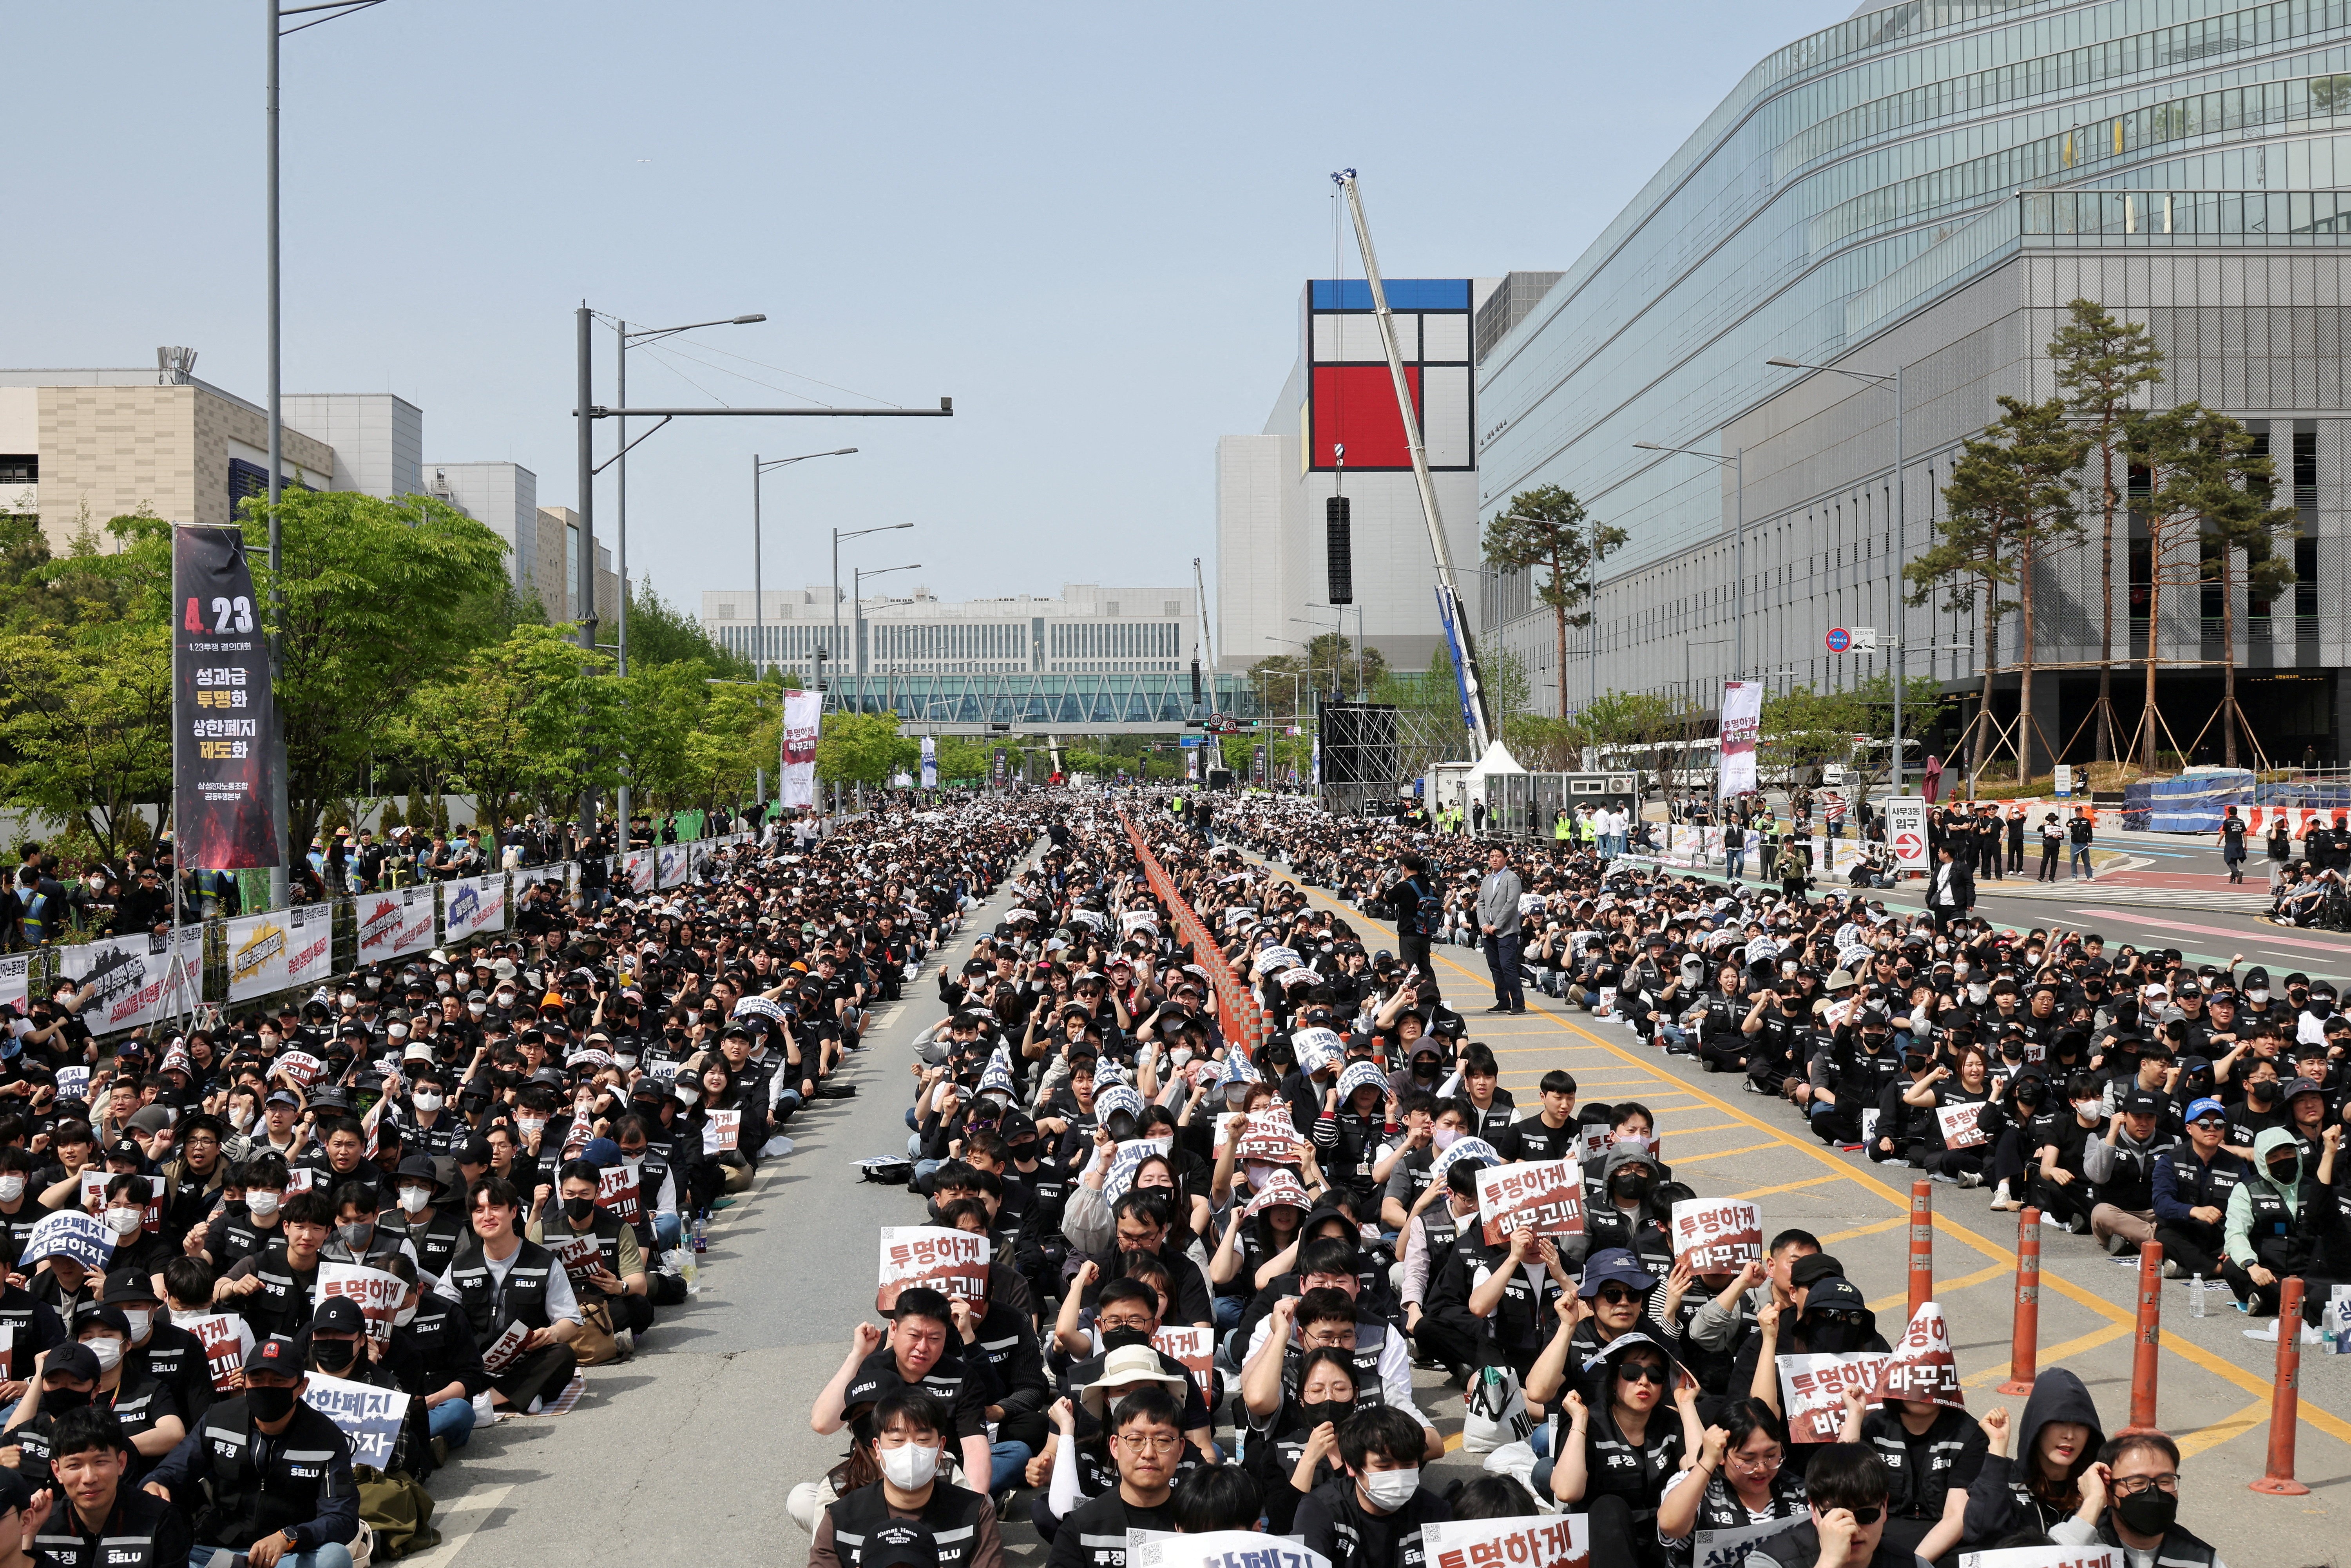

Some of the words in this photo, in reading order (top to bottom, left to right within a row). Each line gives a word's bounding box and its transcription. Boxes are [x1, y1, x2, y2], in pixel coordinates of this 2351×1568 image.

[185, 596, 253, 636] 4.23
[189, 643, 218, 651] 4.23투쟁
[220, 642, 252, 651] 결의대회
[196, 668, 246, 686] 성과급
[197, 690, 248, 708] 투명화
[193, 718, 256, 737] 상한폐지
[1724, 716, 1756, 729] 투명하게
[786, 726, 814, 739] 투명하게
[199, 740, 248, 759] 제도화
[789, 740, 815, 752] 바꾸고!!!
[198, 782, 248, 790] 삼성전자노동조합
[205, 793, 241, 801] 공동투쟁본부
[1896, 819, 1918, 829] 입구
[292, 913, 302, 925] NSEU
[1076, 913, 1099, 922] 상한폐지
[1126, 913, 1153, 925] 투명하게
[149, 937, 166, 951] NSEU
[1748, 939, 1776, 952] 상한폐지
[111, 970, 128, 990] 경영진
[740, 999, 782, 1012] 상한폐지
[1299, 1032, 1340, 1053] 상한폐지
[58, 1070, 81, 1086] 폐지
[58, 1086, 87, 1098] 하자
[400, 1132, 414, 1141] 투쟁
[2234, 1132, 2249, 1143] 투쟁
[459, 1140, 468, 1151] LA
[1529, 1141, 1544, 1150] 투쟁
[2179, 1170, 2193, 1180] 투쟁
[316, 1177, 328, 1186] 투쟁
[1415, 1179, 1430, 1187] 투쟁
[1485, 1164, 1567, 1206] 투명하게
[1040, 1190, 1058, 1198] SELU
[607, 1197, 638, 1217] 고!!!
[1499, 1199, 1579, 1235] 바꾸고!!!
[1598, 1217, 1617, 1226] 투쟁
[1679, 1206, 1755, 1239] 투명하게
[36, 1217, 107, 1239] 상한폐지
[229, 1235, 249, 1248] 투쟁
[1434, 1234, 1454, 1244] 투쟁
[32, 1237, 109, 1266] 실현하자
[889, 1237, 979, 1269] 투명하게
[1691, 1243, 1761, 1269] 바꾸고!!!
[1647, 1263, 1669, 1273] 투쟁
[463, 1278, 483, 1288] 투쟁
[515, 1280, 536, 1288] SELU
[266, 1284, 286, 1296] 투쟁
[325, 1277, 400, 1305] 투명하게
[1505, 1287, 1525, 1299] 투쟁
[330, 1310, 337, 1318] C
[3, 1319, 26, 1327] SELU
[417, 1324, 440, 1333] SELU
[1153, 1331, 1199, 1358] 하게
[989, 1353, 1009, 1363] SELU
[1353, 1357, 1377, 1369] SELU
[152, 1363, 177, 1372] SELU
[209, 1353, 240, 1381] 고!!!
[851, 1381, 877, 1397] NSEU
[1933, 1398, 1958, 1407] 삼성전자노동조합
[120, 1412, 145, 1423] SELU
[22, 1441, 50, 1458] 투쟁
[214, 1440, 237, 1458] 투쟁
[1608, 1455, 1636, 1468] 투쟁
[291, 1468, 319, 1478] SELU
[877, 1528, 898, 1539] Kunst
[900, 1527, 918, 1538] Haus
[109, 1552, 141, 1563] SELU
[1094, 1550, 1125, 1566] 투쟁
